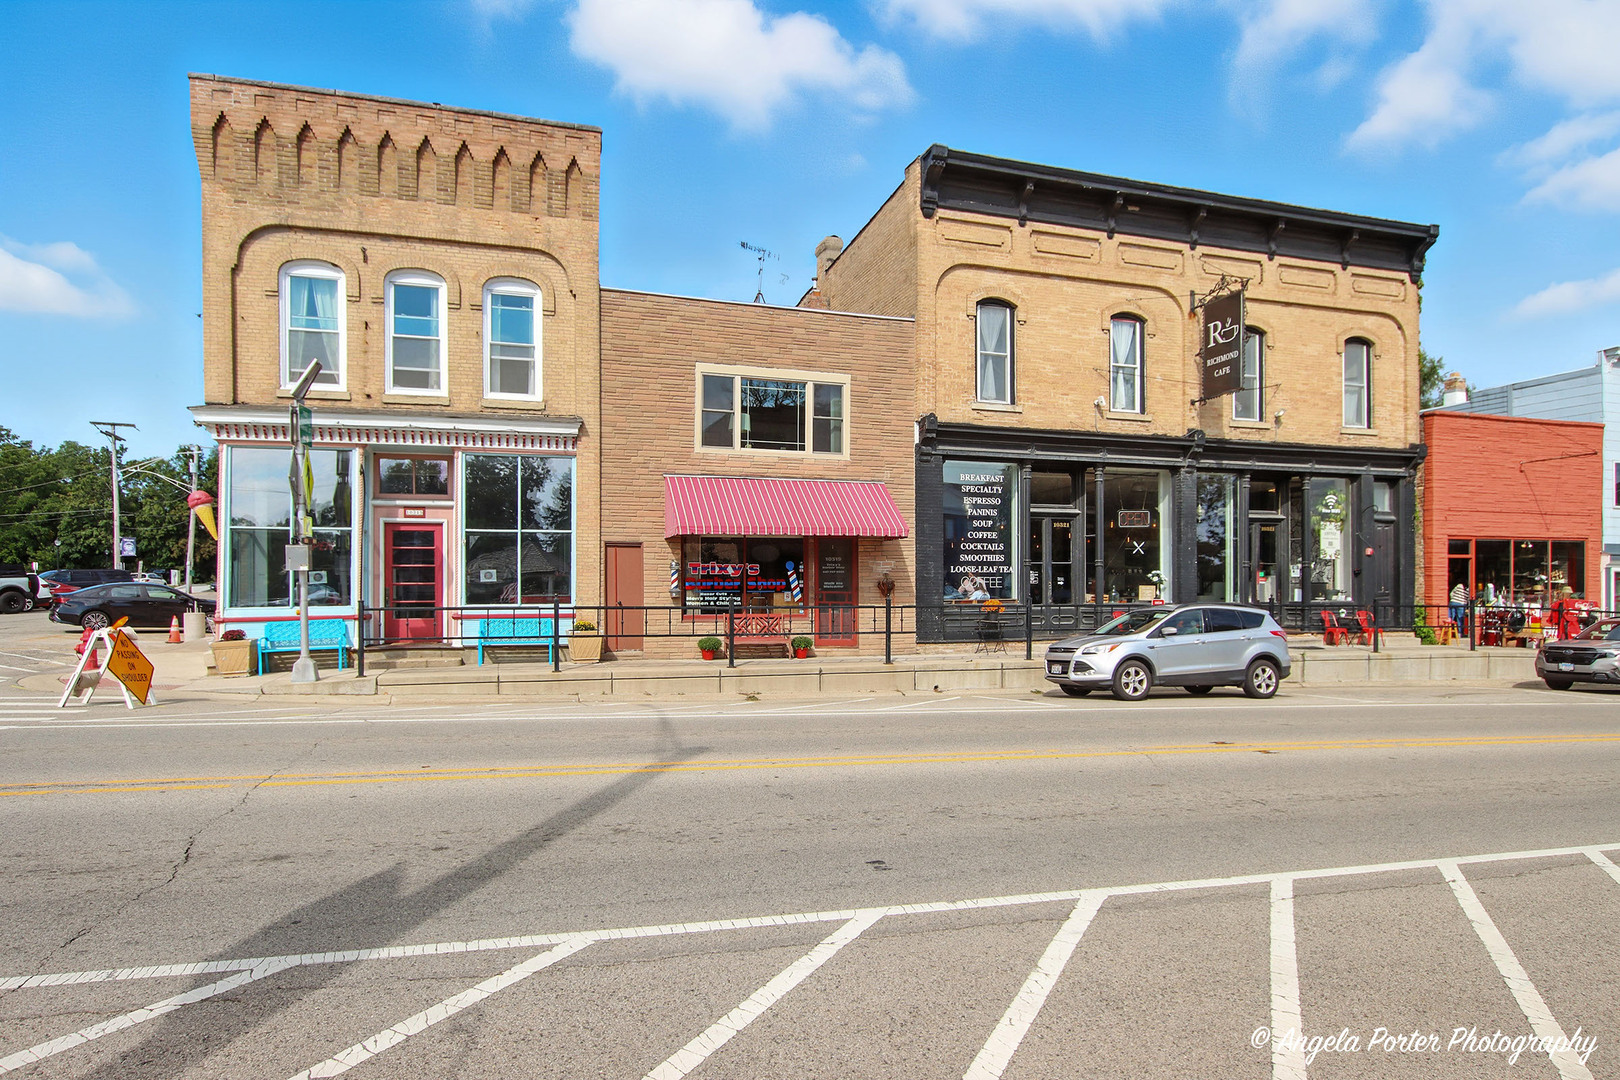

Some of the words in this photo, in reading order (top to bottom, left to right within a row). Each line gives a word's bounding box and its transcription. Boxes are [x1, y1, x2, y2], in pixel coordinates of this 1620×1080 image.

[1206, 350, 1239, 367] RICHMOND
[1214, 365, 1231, 377] CAFE
[960, 473, 1005, 483] BREAKFAST
[961, 485, 1003, 494] SPECIALTY
[963, 496, 1001, 505] ESPRESSO
[967, 508, 998, 516] PANINIS
[972, 519, 993, 528] SOUP
[1120, 512, 1149, 526] OPEN
[967, 531, 998, 539] COFFEE
[960, 542, 1005, 551] COCKTAILS
[959, 554, 1005, 562] SMOOTHIES
[688, 562, 760, 577] Trixy's
[950, 565, 999, 573] LOOSE-LEAF
[685, 576, 741, 591] Barber
[747, 576, 787, 592] Shop
[120, 639, 129, 648] NO
[116, 650, 140, 660] PASSING
[127, 662, 137, 671] ON
[121, 673, 149, 682] SHOULDER
